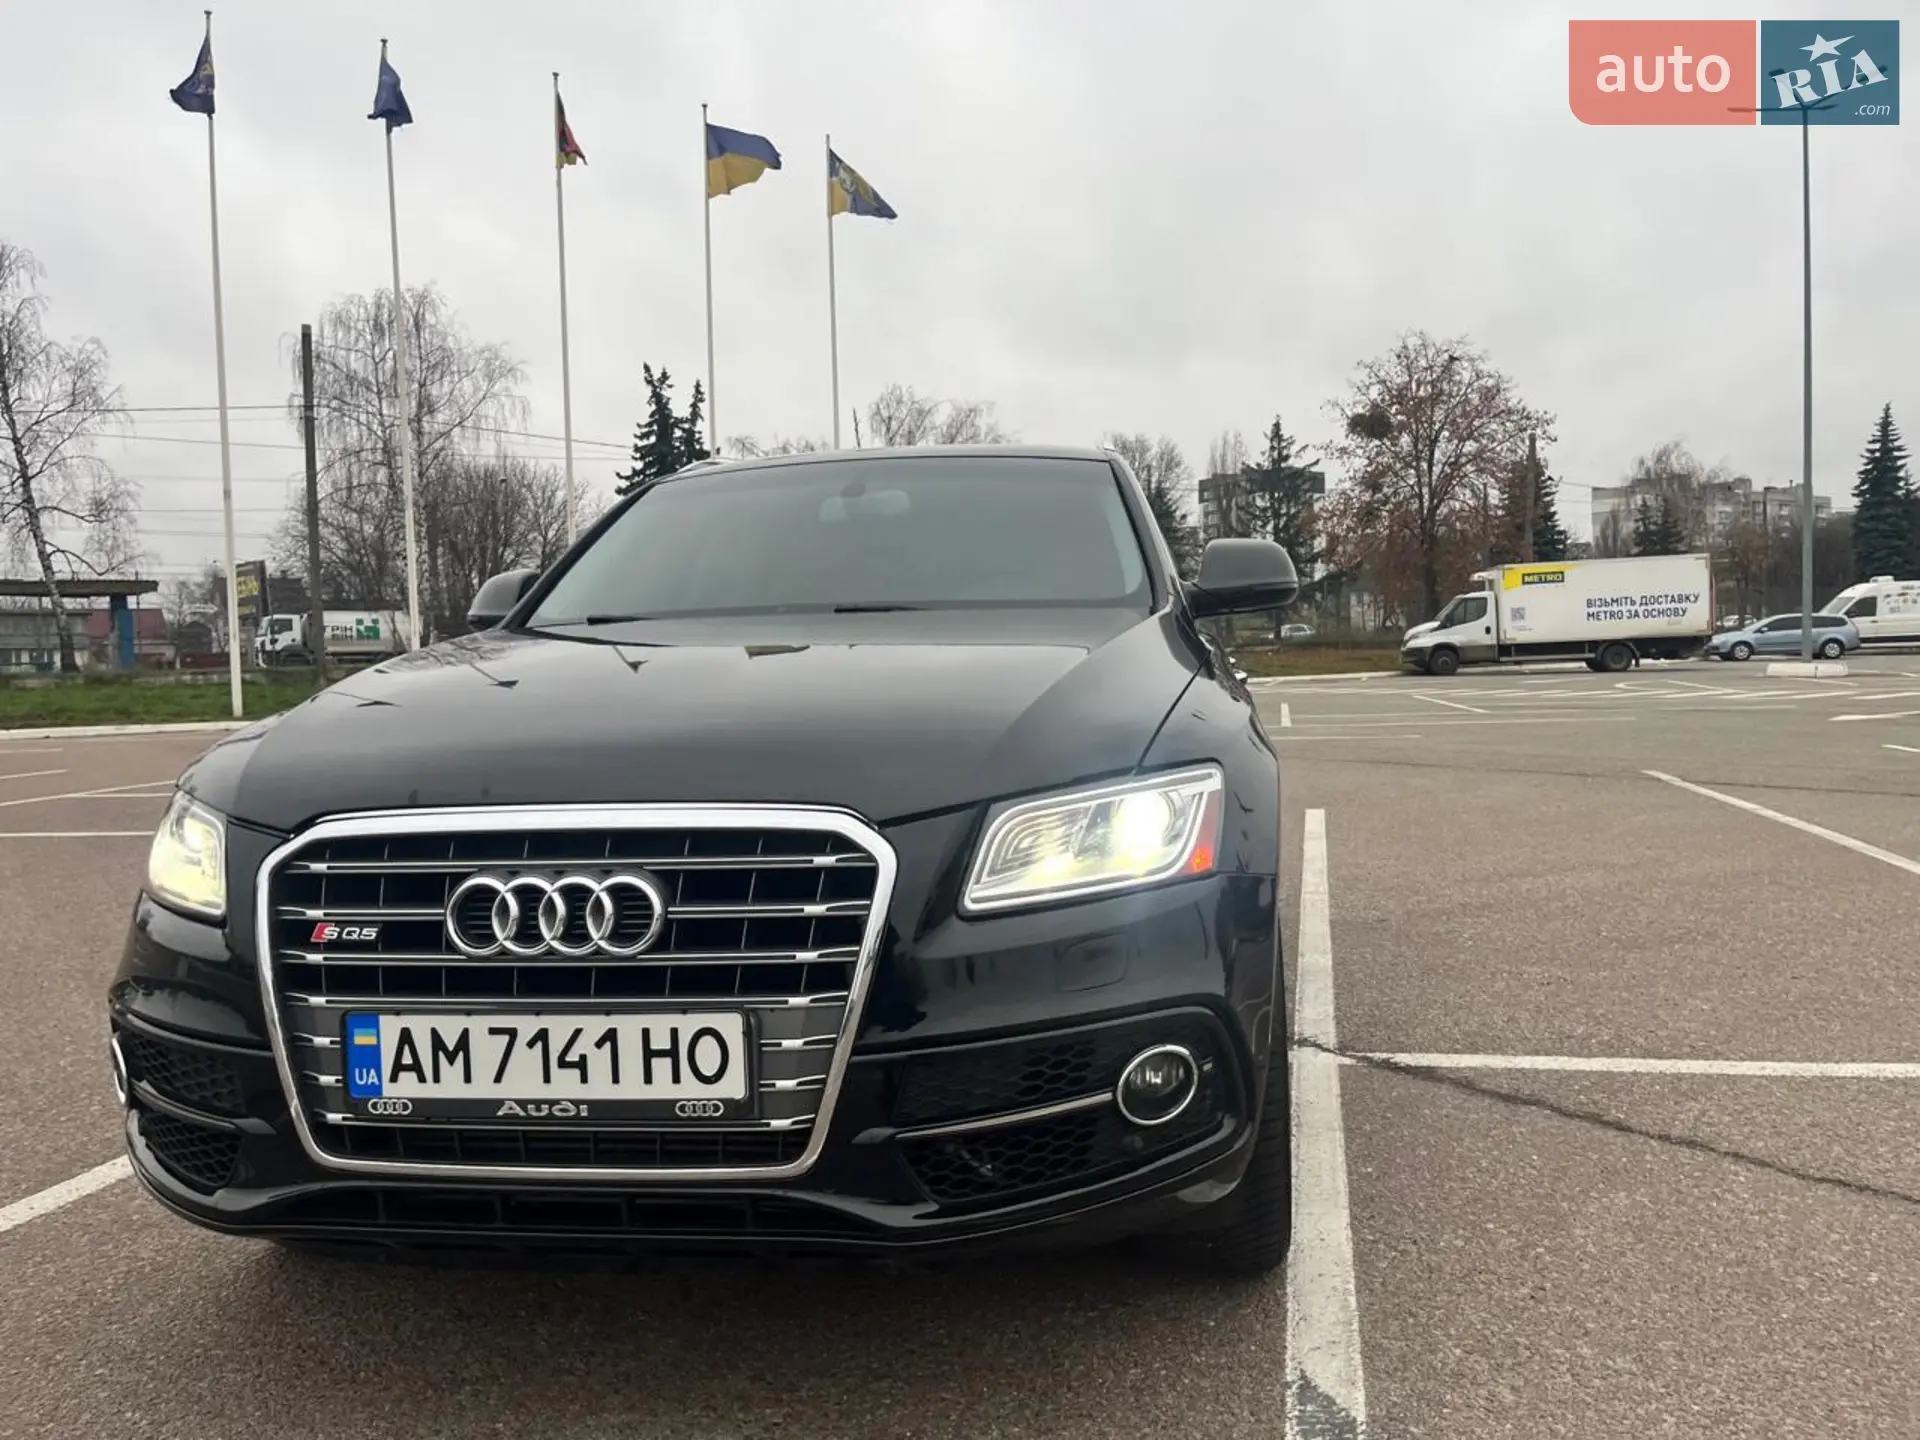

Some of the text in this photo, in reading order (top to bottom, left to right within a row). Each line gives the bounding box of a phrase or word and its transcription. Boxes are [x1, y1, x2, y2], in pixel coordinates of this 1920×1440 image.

[1523, 572, 1563, 583] METRO
[1586, 593, 1699, 608] ВІЗЬМІТЬ ДОСТАВКУ
[1626, 609, 1640, 619] ЗА
[1643, 607, 1687, 618] ОСНОВУ
[389, 1026, 472, 1084] AM
[488, 1026, 622, 1085] 7141
[355, 1067, 380, 1086] UA
[496, 1101, 588, 1116] Audi
